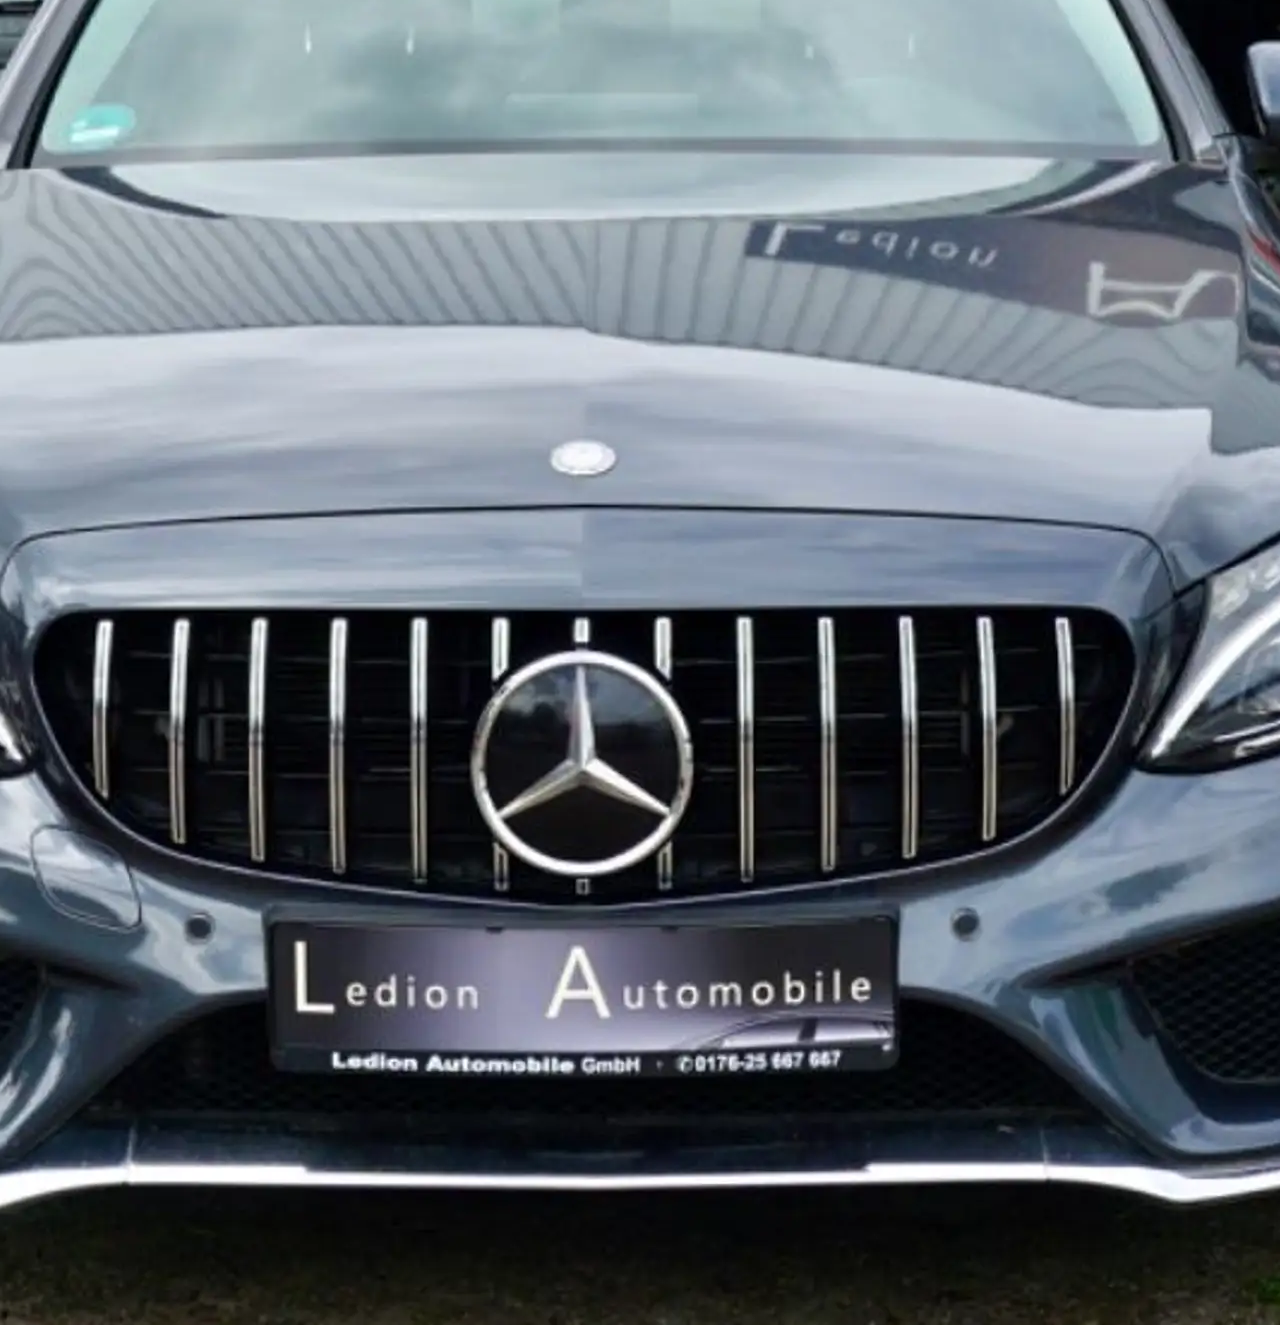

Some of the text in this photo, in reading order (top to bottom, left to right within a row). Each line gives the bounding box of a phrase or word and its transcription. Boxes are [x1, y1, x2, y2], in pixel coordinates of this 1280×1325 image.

[293, 940, 873, 1019] Ledion Automobile
[331, 1051, 419, 1072] Ledion
[425, 1053, 576, 1074] Automobile
[580, 1056, 642, 1074] GmbH
